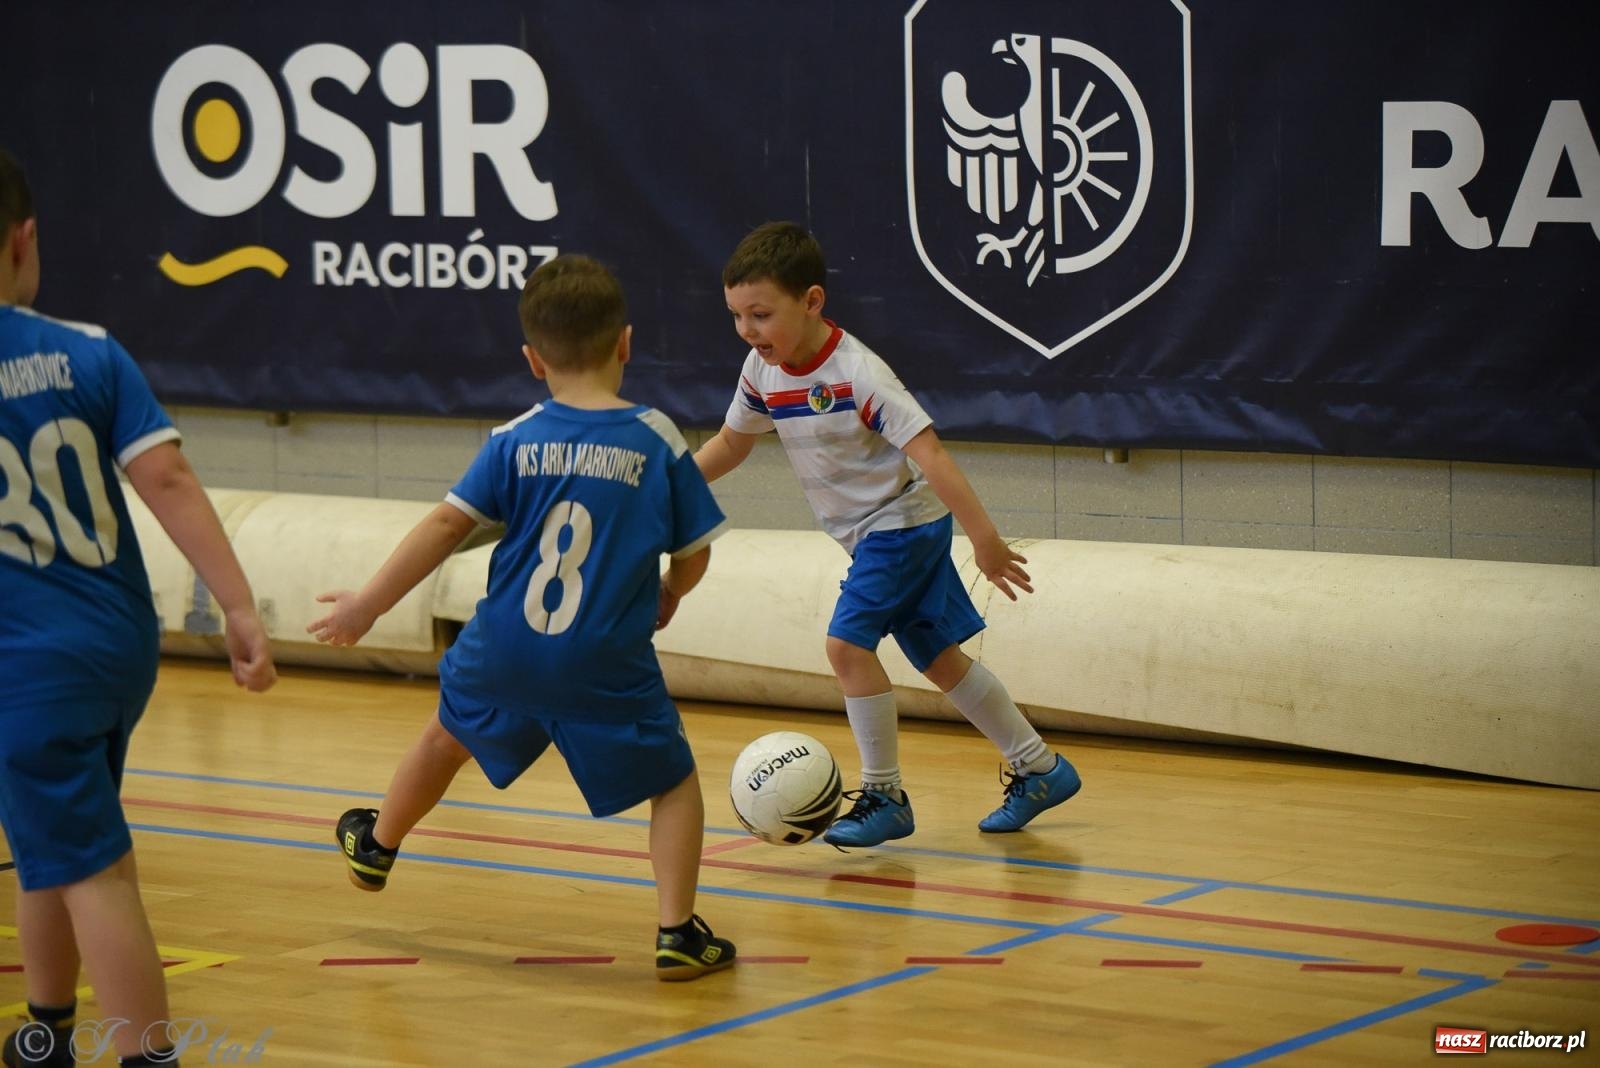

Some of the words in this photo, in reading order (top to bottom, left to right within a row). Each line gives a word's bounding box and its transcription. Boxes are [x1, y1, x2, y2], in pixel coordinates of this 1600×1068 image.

[151, 42, 559, 221] OSiR
[1381, 99, 1600, 250] RA
[541, 442, 573, 476] ARKA
[573, 443, 647, 487] MARKOWICE
[524, 500, 592, 635] 8
[749, 745, 811, 792] macron
